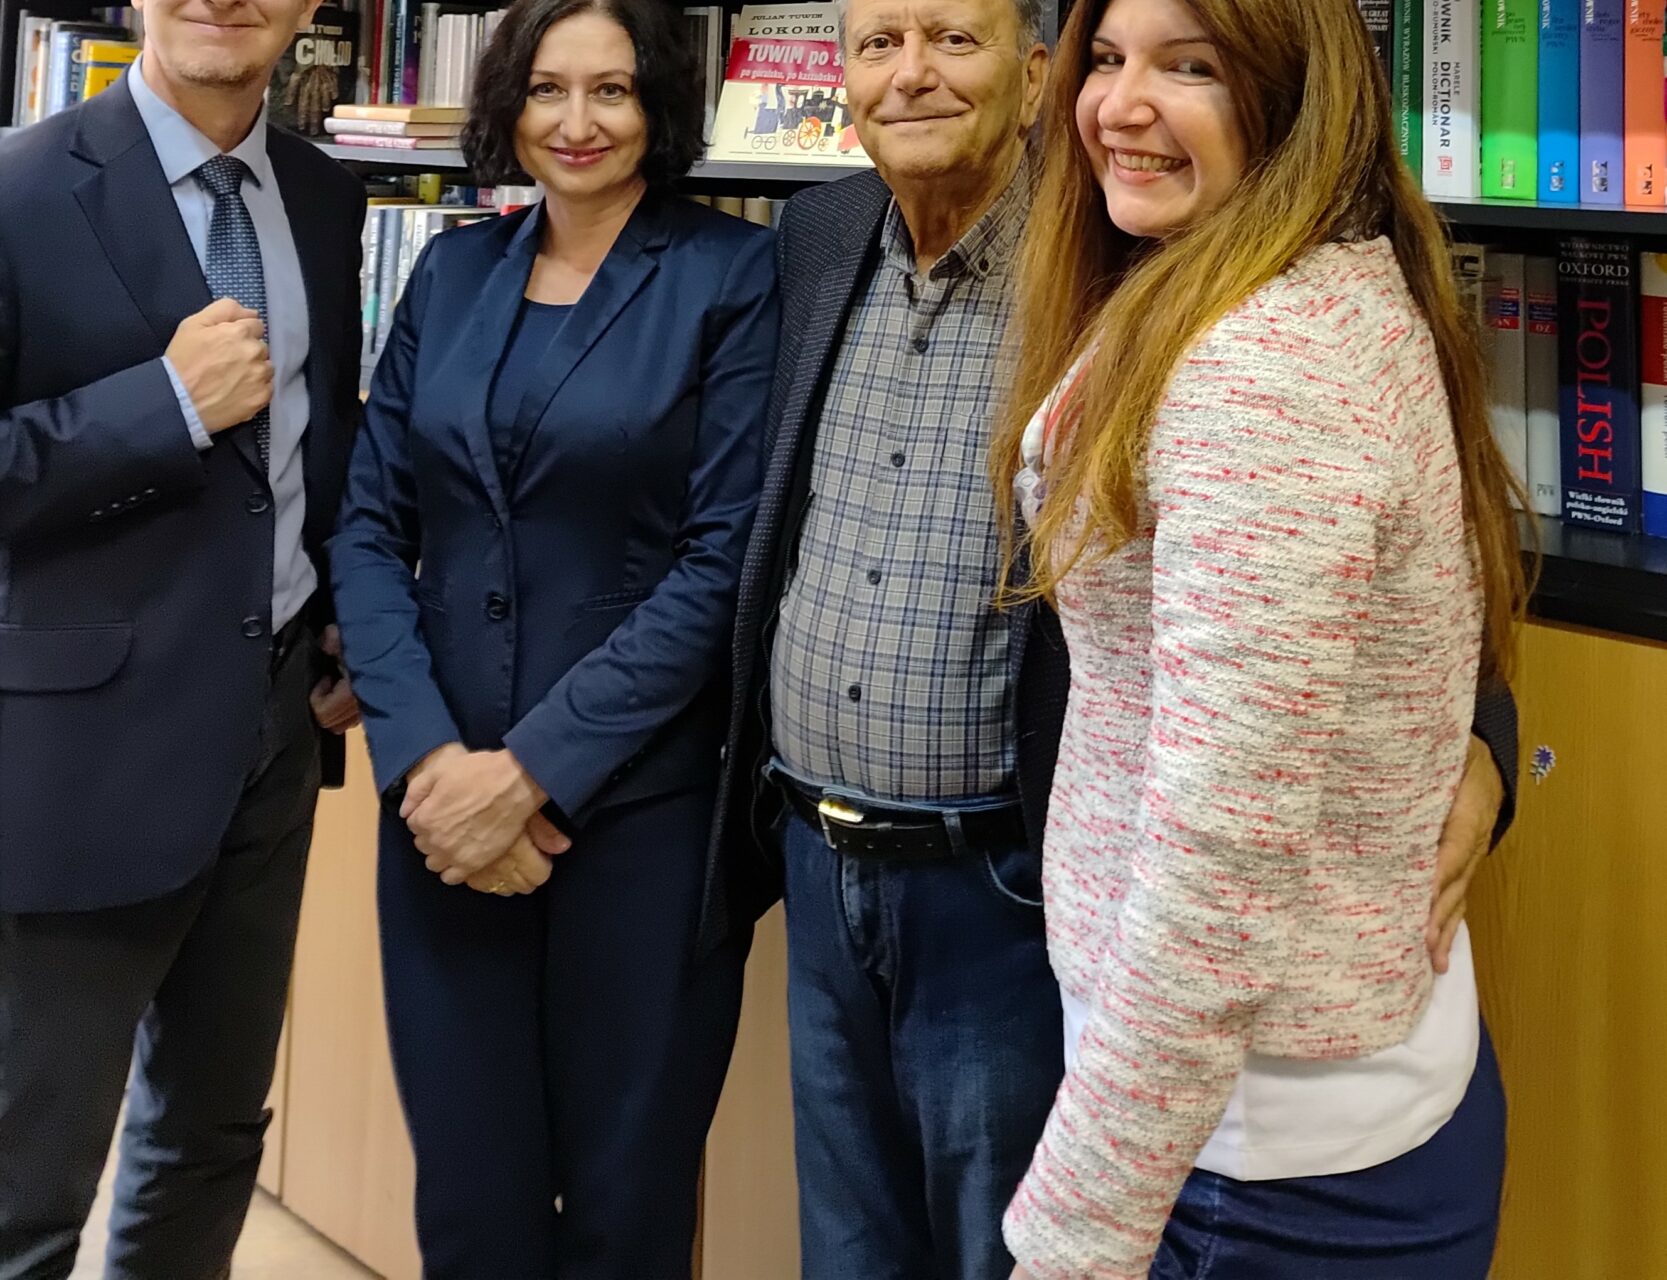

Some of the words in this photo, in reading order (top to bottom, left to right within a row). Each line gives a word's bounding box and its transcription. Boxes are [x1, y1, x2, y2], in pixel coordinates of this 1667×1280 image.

[751, 13, 785, 21] JULIAN
[787, 12, 824, 20] TUWIM
[748, 24, 836, 36] LOKOMO
[747, 43, 805, 65] TUWIM
[807, 50, 830, 71] po
[786, 72, 797, 82] po
[1558, 260, 1631, 277] OXFORD
[1577, 297, 1613, 485] POLISH
[1568, 490, 1593, 502] Wielki
[1594, 495, 1625, 506] słownik
[1571, 511, 1623, 526] PWN-Oxford
